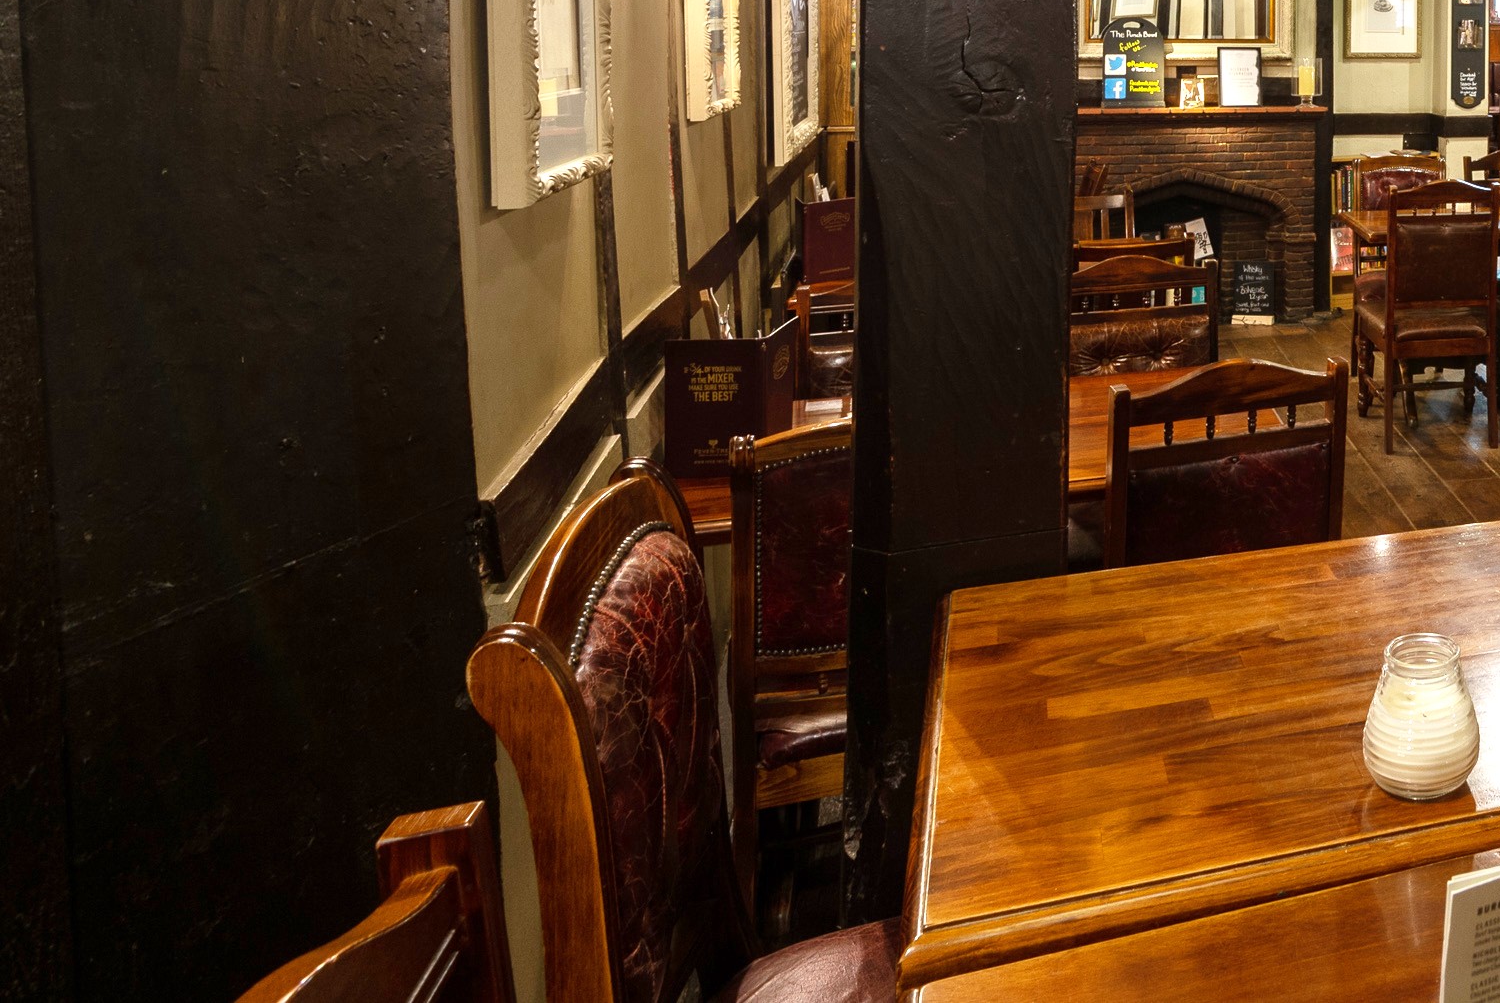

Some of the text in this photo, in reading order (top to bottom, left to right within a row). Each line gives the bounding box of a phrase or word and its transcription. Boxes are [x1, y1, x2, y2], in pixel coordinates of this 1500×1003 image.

[1110, 30, 1125, 38] The
[1126, 29, 1142, 38] Punch
[693, 391, 733, 402] THE BEST
